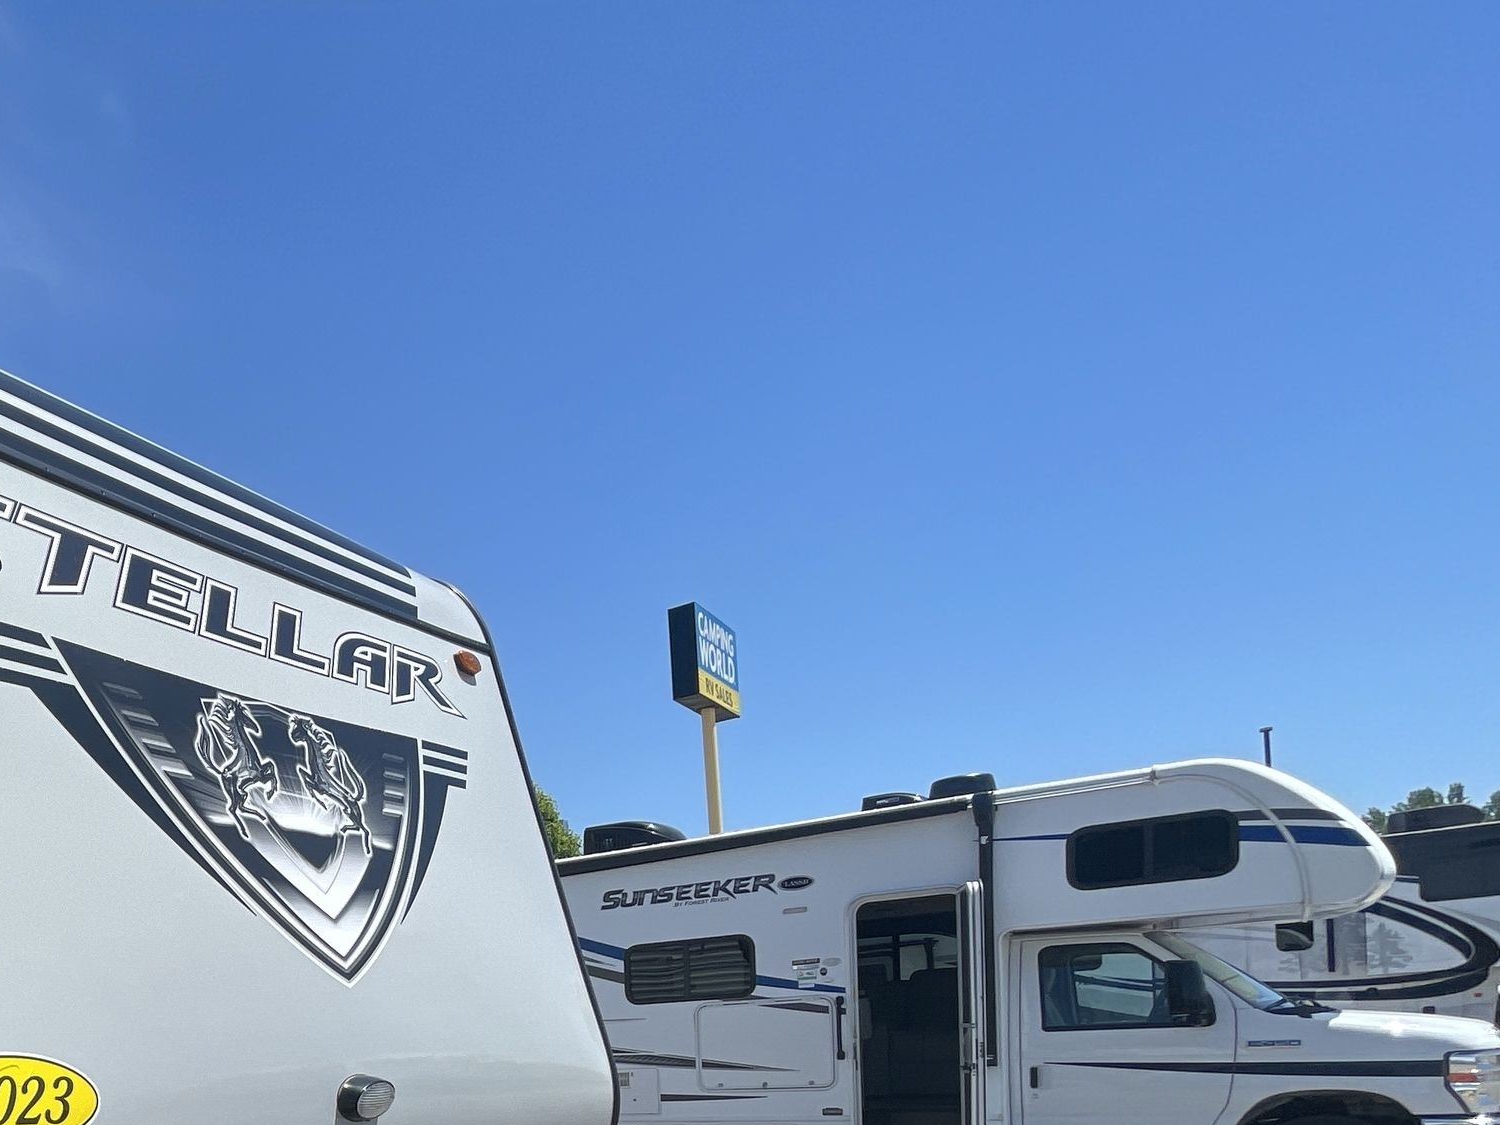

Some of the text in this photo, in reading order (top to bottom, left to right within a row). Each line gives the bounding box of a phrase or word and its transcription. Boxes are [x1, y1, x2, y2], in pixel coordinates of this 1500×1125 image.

[698, 611, 735, 658] CAMPING
[699, 635, 736, 684] WORLD
[705, 677, 734, 708] RV SALES
